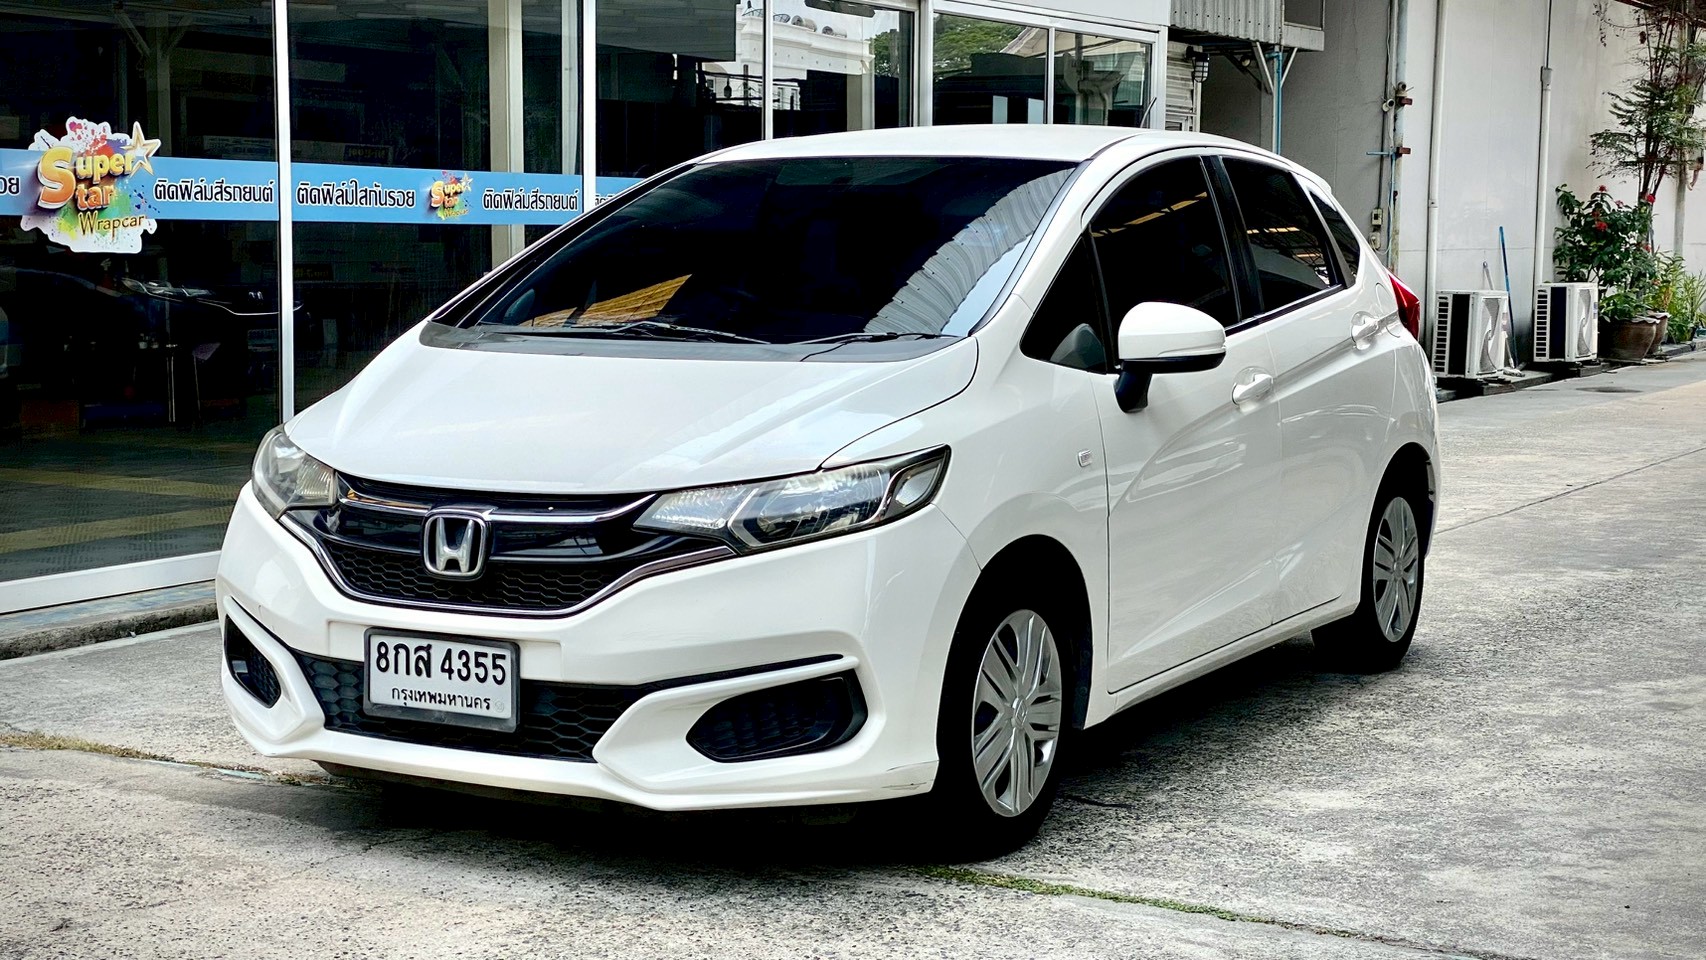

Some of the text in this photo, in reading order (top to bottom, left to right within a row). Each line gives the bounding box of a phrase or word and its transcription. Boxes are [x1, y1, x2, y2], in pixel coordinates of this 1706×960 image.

[38, 146, 135, 209] Super
[154, 179, 275, 203] ติดฟิล์มสีรถยนต์
[297, 179, 415, 207] ติดฟิล์มใสกันรอย
[483, 188, 579, 211] ติดฟิล์มสีรถยนต์
[78, 211, 145, 240] Wrapcar
[376, 641, 507, 685] 8กส 4355
[391, 687, 491, 710] กรุงเทพมหานคร
